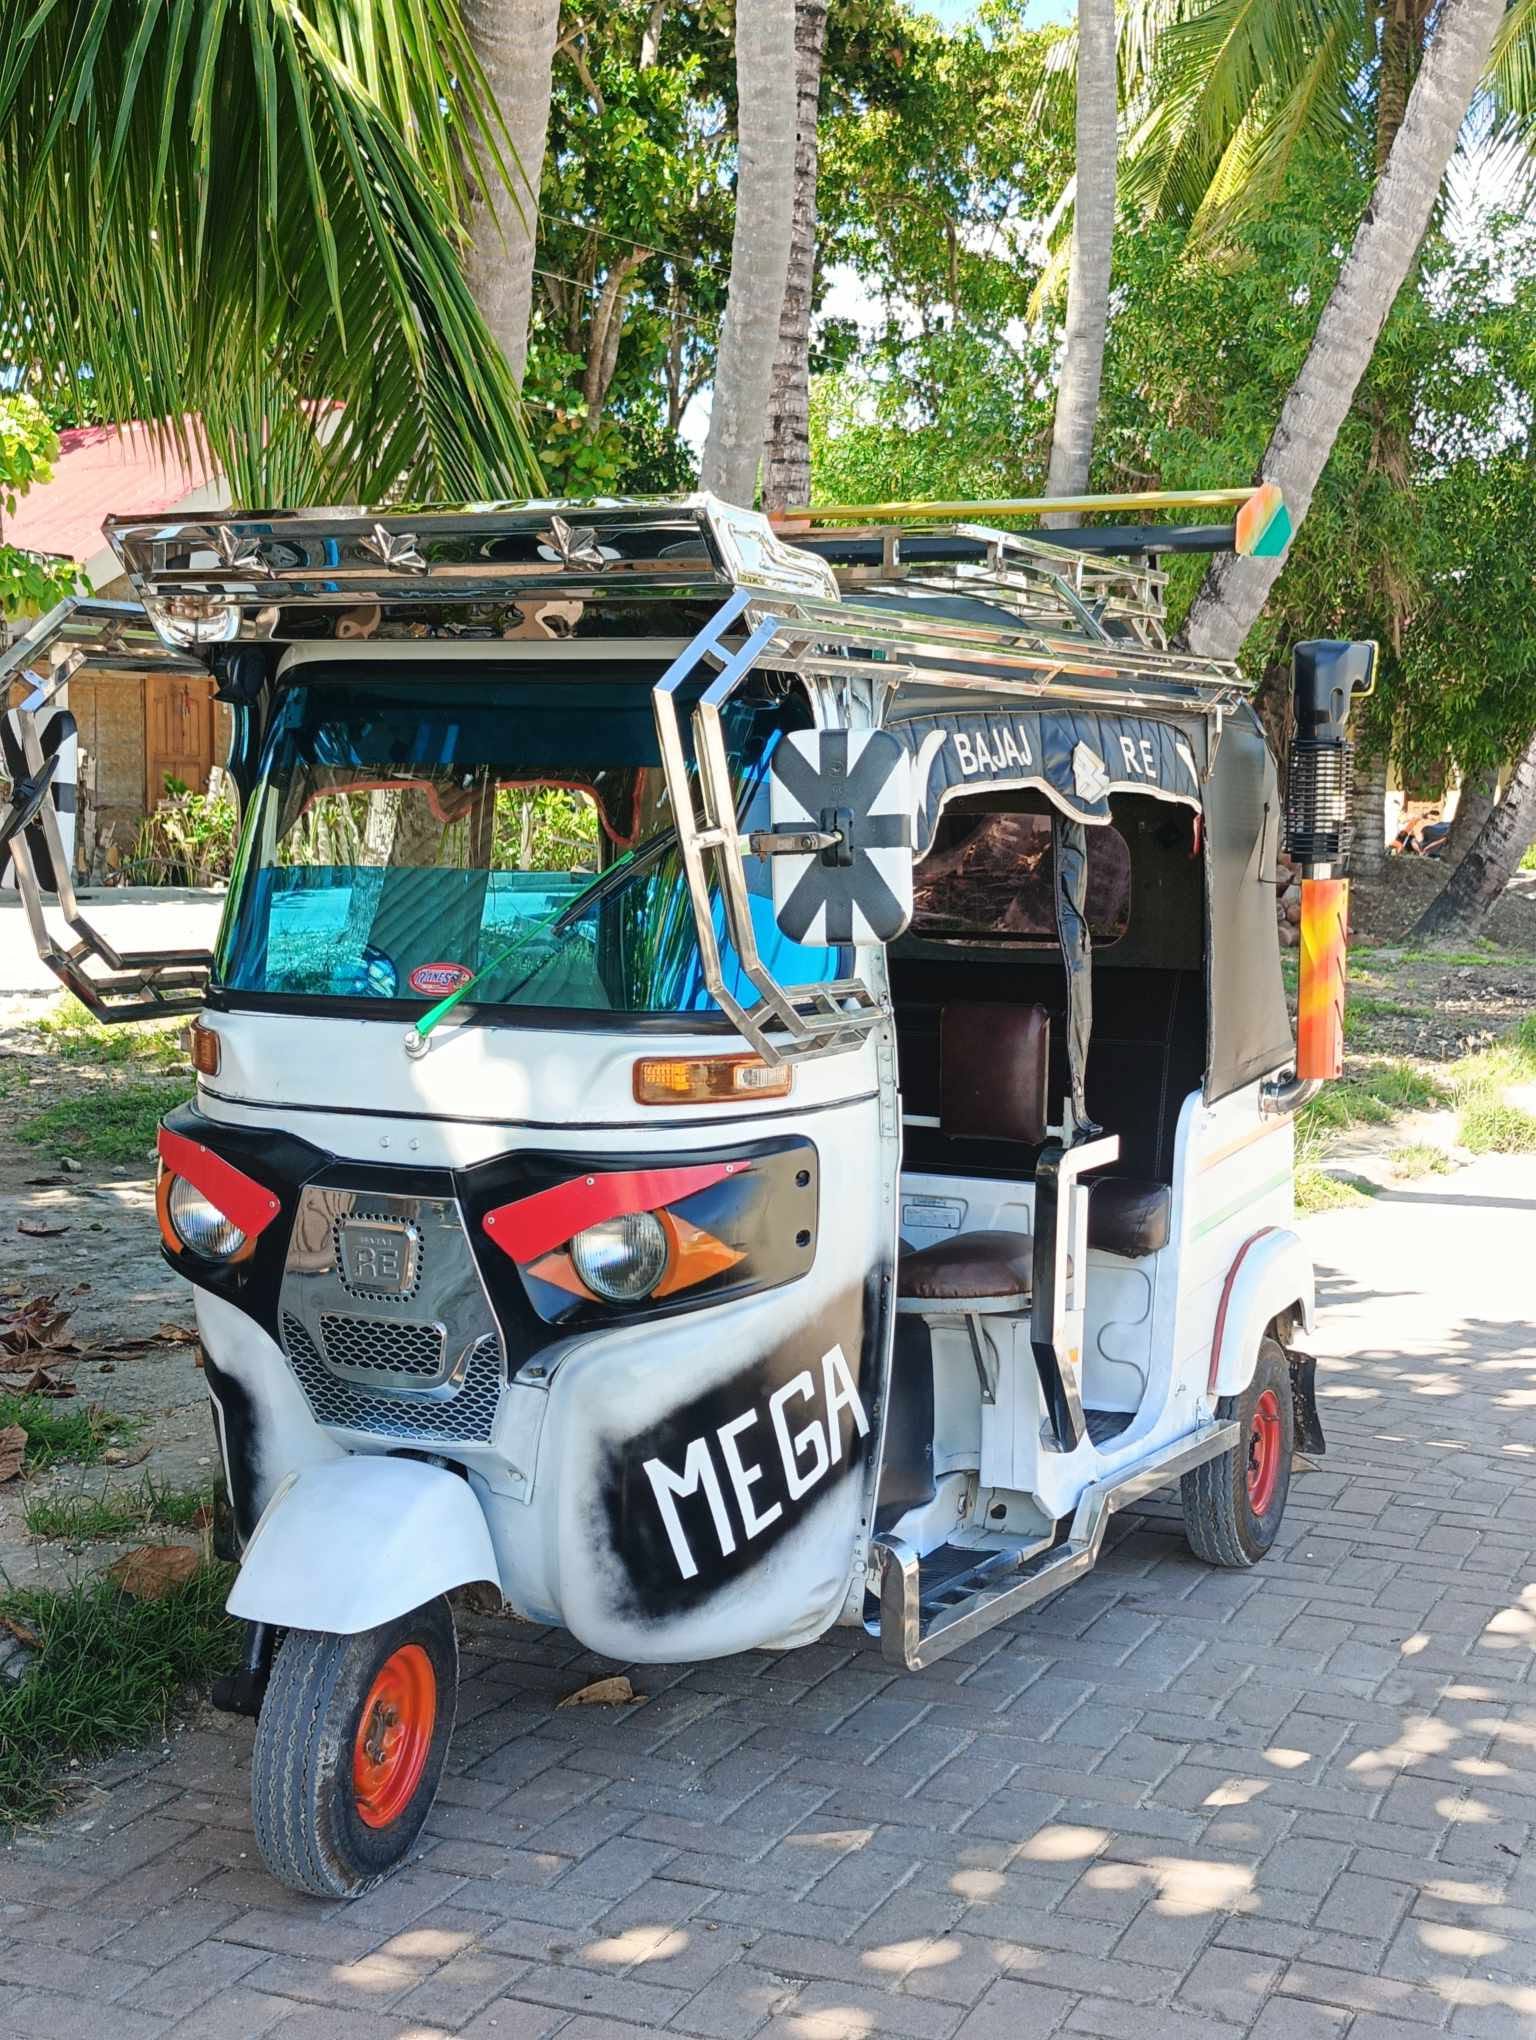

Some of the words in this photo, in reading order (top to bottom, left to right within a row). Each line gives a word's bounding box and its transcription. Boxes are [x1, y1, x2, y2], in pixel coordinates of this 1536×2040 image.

[953, 725, 1033, 776] BAJAJ
[1119, 735, 1158, 779] RE
[353, 1246, 400, 1280] RE
[642, 1343, 871, 1580] MEGA
